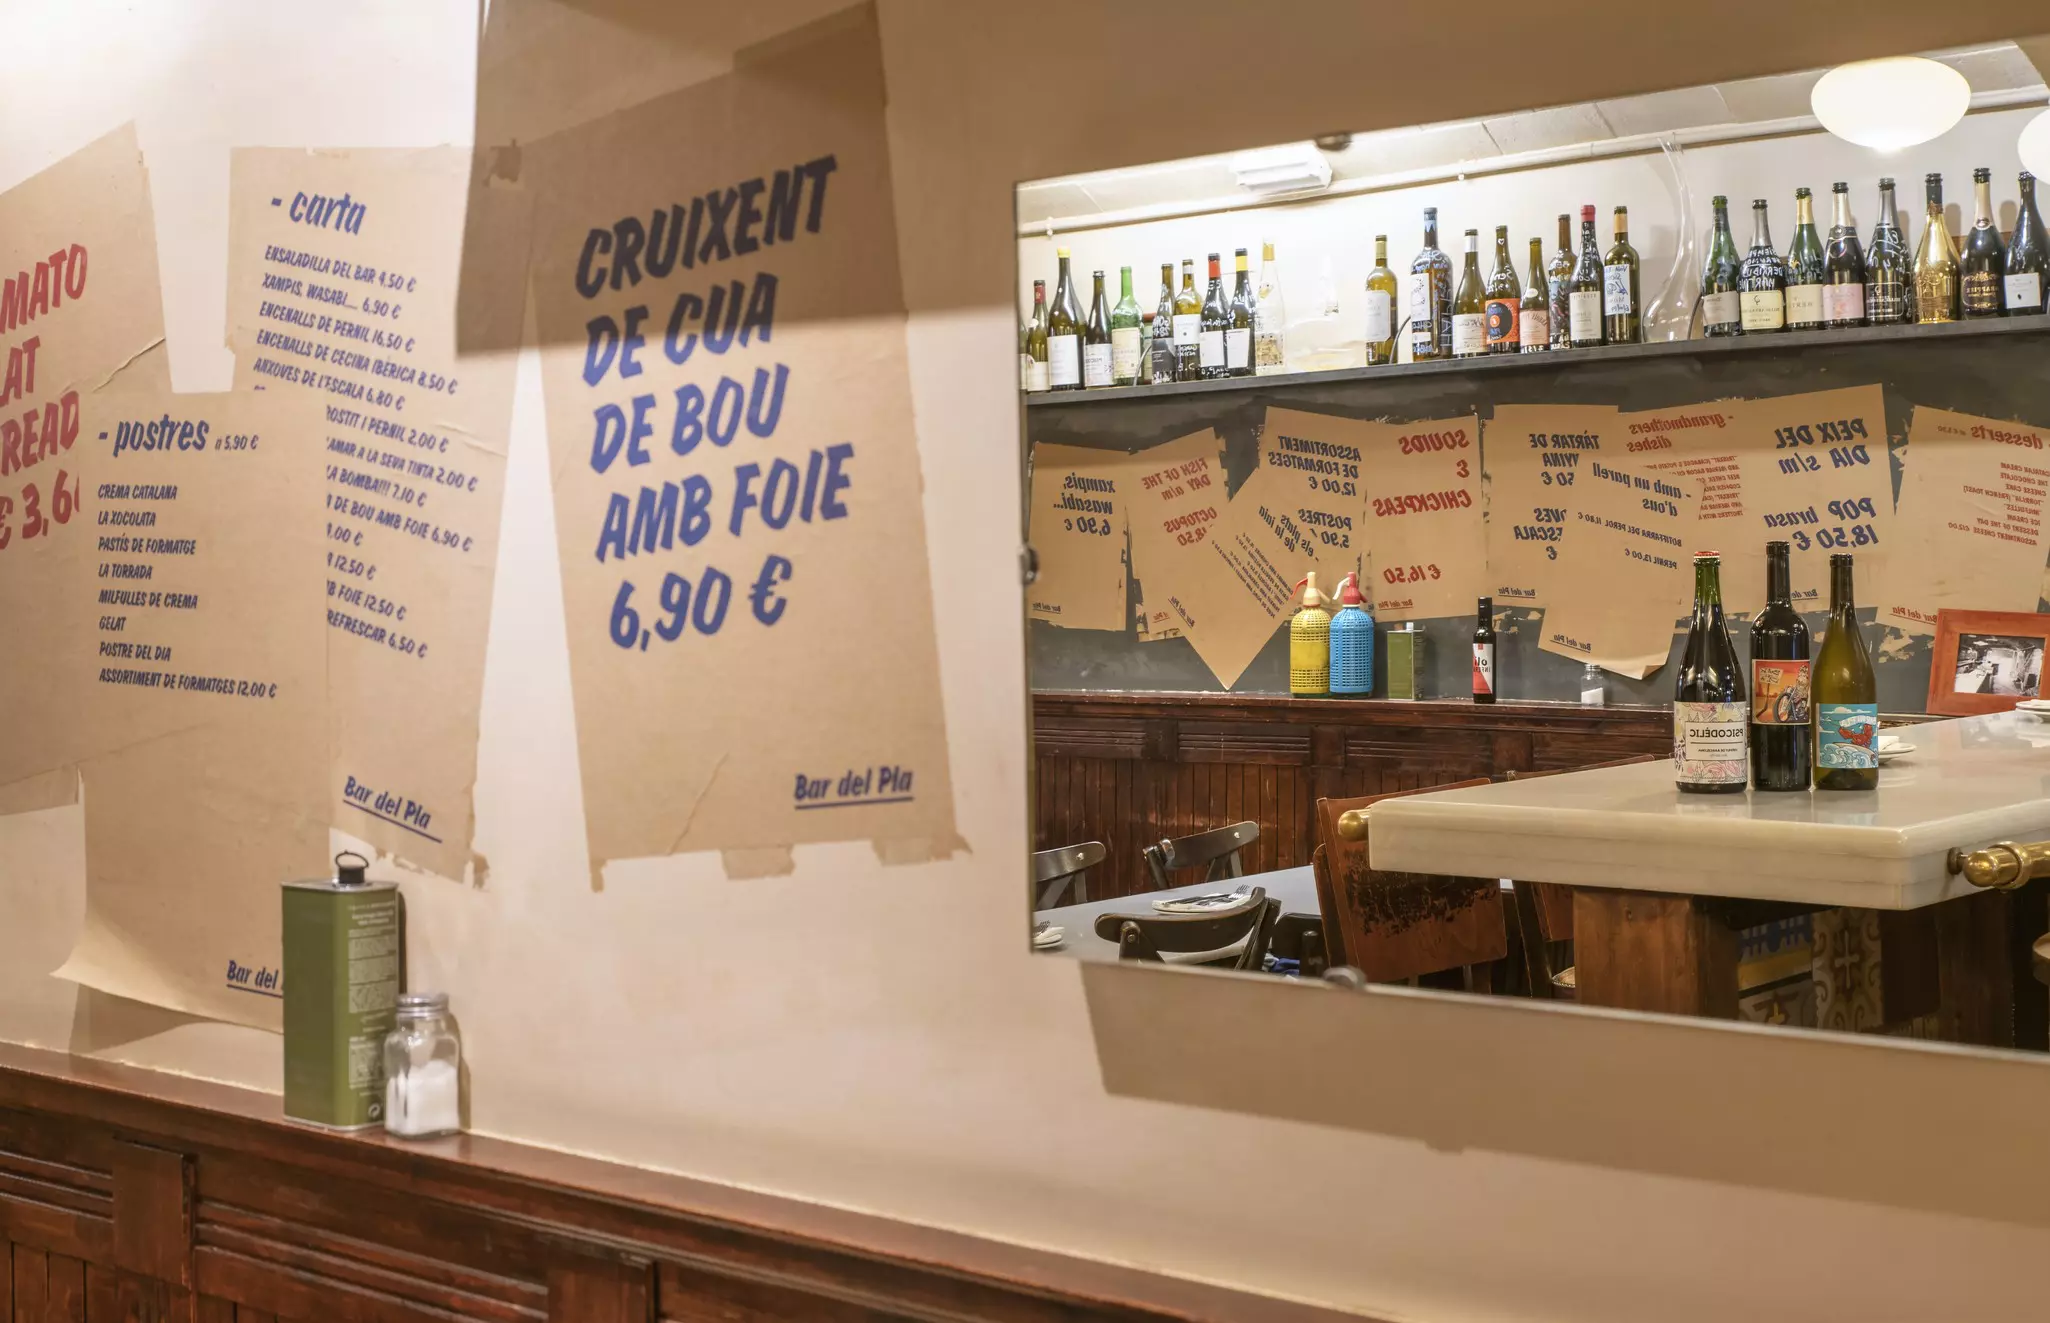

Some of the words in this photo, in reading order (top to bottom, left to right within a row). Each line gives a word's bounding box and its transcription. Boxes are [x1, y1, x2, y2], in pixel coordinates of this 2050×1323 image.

[290, 192, 366, 236] carta
[575, 154, 837, 300] CRUIXENT
[265, 246, 330, 273] ENSALADILLA
[333, 261, 351, 279] DEL
[355, 266, 375, 284] BAR
[0, 243, 87, 334] MATO
[260, 301, 316, 329] ENCENALLS
[318, 316, 332, 333] DE
[334, 320, 369, 343] PERNIL
[582, 304, 650, 388] DE
[664, 272, 779, 366] CUA
[257, 330, 313, 357] ENCENALLS
[315, 344, 329, 361] DE
[331, 348, 369, 371] CECINA
[254, 358, 300, 383] ANXOVES
[302, 370, 316, 388] DE
[113, 414, 209, 458] postres
[368, 418, 405, 442] PERNIL
[588, 393, 657, 475] DE
[670, 362, 790, 457] BOU
[339, 468, 391, 496] BOMBA!!!
[380, 452, 405, 472] SEVA
[407, 460, 434, 479] TINTA
[22, 469, 79, 539] 3,6
[98, 484, 130, 499] CREMA
[132, 484, 177, 500] CATALANA
[595, 474, 713, 564] AMB
[729, 442, 855, 537] FOIE
[98, 510, 108, 525] LA
[110, 511, 156, 526] XOCOLATA
[334, 496, 350, 514] DE
[351, 501, 375, 521] BOU
[376, 509, 401, 530] AMB
[403, 517, 430, 539] FOIE
[98, 532, 129, 552] PASTÍS
[132, 538, 143, 553] DE
[146, 539, 196, 554] FORMATGE
[98, 563, 108, 578] LA
[112, 564, 152, 579] TORRADA
[99, 589, 146, 607] MILFULLES
[149, 592, 160, 607] DE
[164, 593, 198, 609] CREMA
[338, 584, 363, 606] FOIE
[609, 565, 732, 653] 6,90
[748, 554, 793, 627] €
[99, 616, 126, 631] GELAT
[327, 608, 386, 644] REFRESCAR
[99, 642, 133, 659] POSTRE
[135, 644, 151, 660] DEL
[154, 646, 171, 661] DIA
[99, 668, 162, 688] ASSORTIMENT
[164, 674, 176, 689] DE
[178, 675, 234, 695] FORMATGES
[794, 773, 832, 800] Bar
[837, 768, 872, 798] del
[878, 765, 912, 793] Pla
[344, 776, 372, 806] Bar
[374, 790, 402, 818] del
[404, 800, 431, 829] Pla
[227, 960, 252, 985] Bar
[255, 966, 278, 990] del
